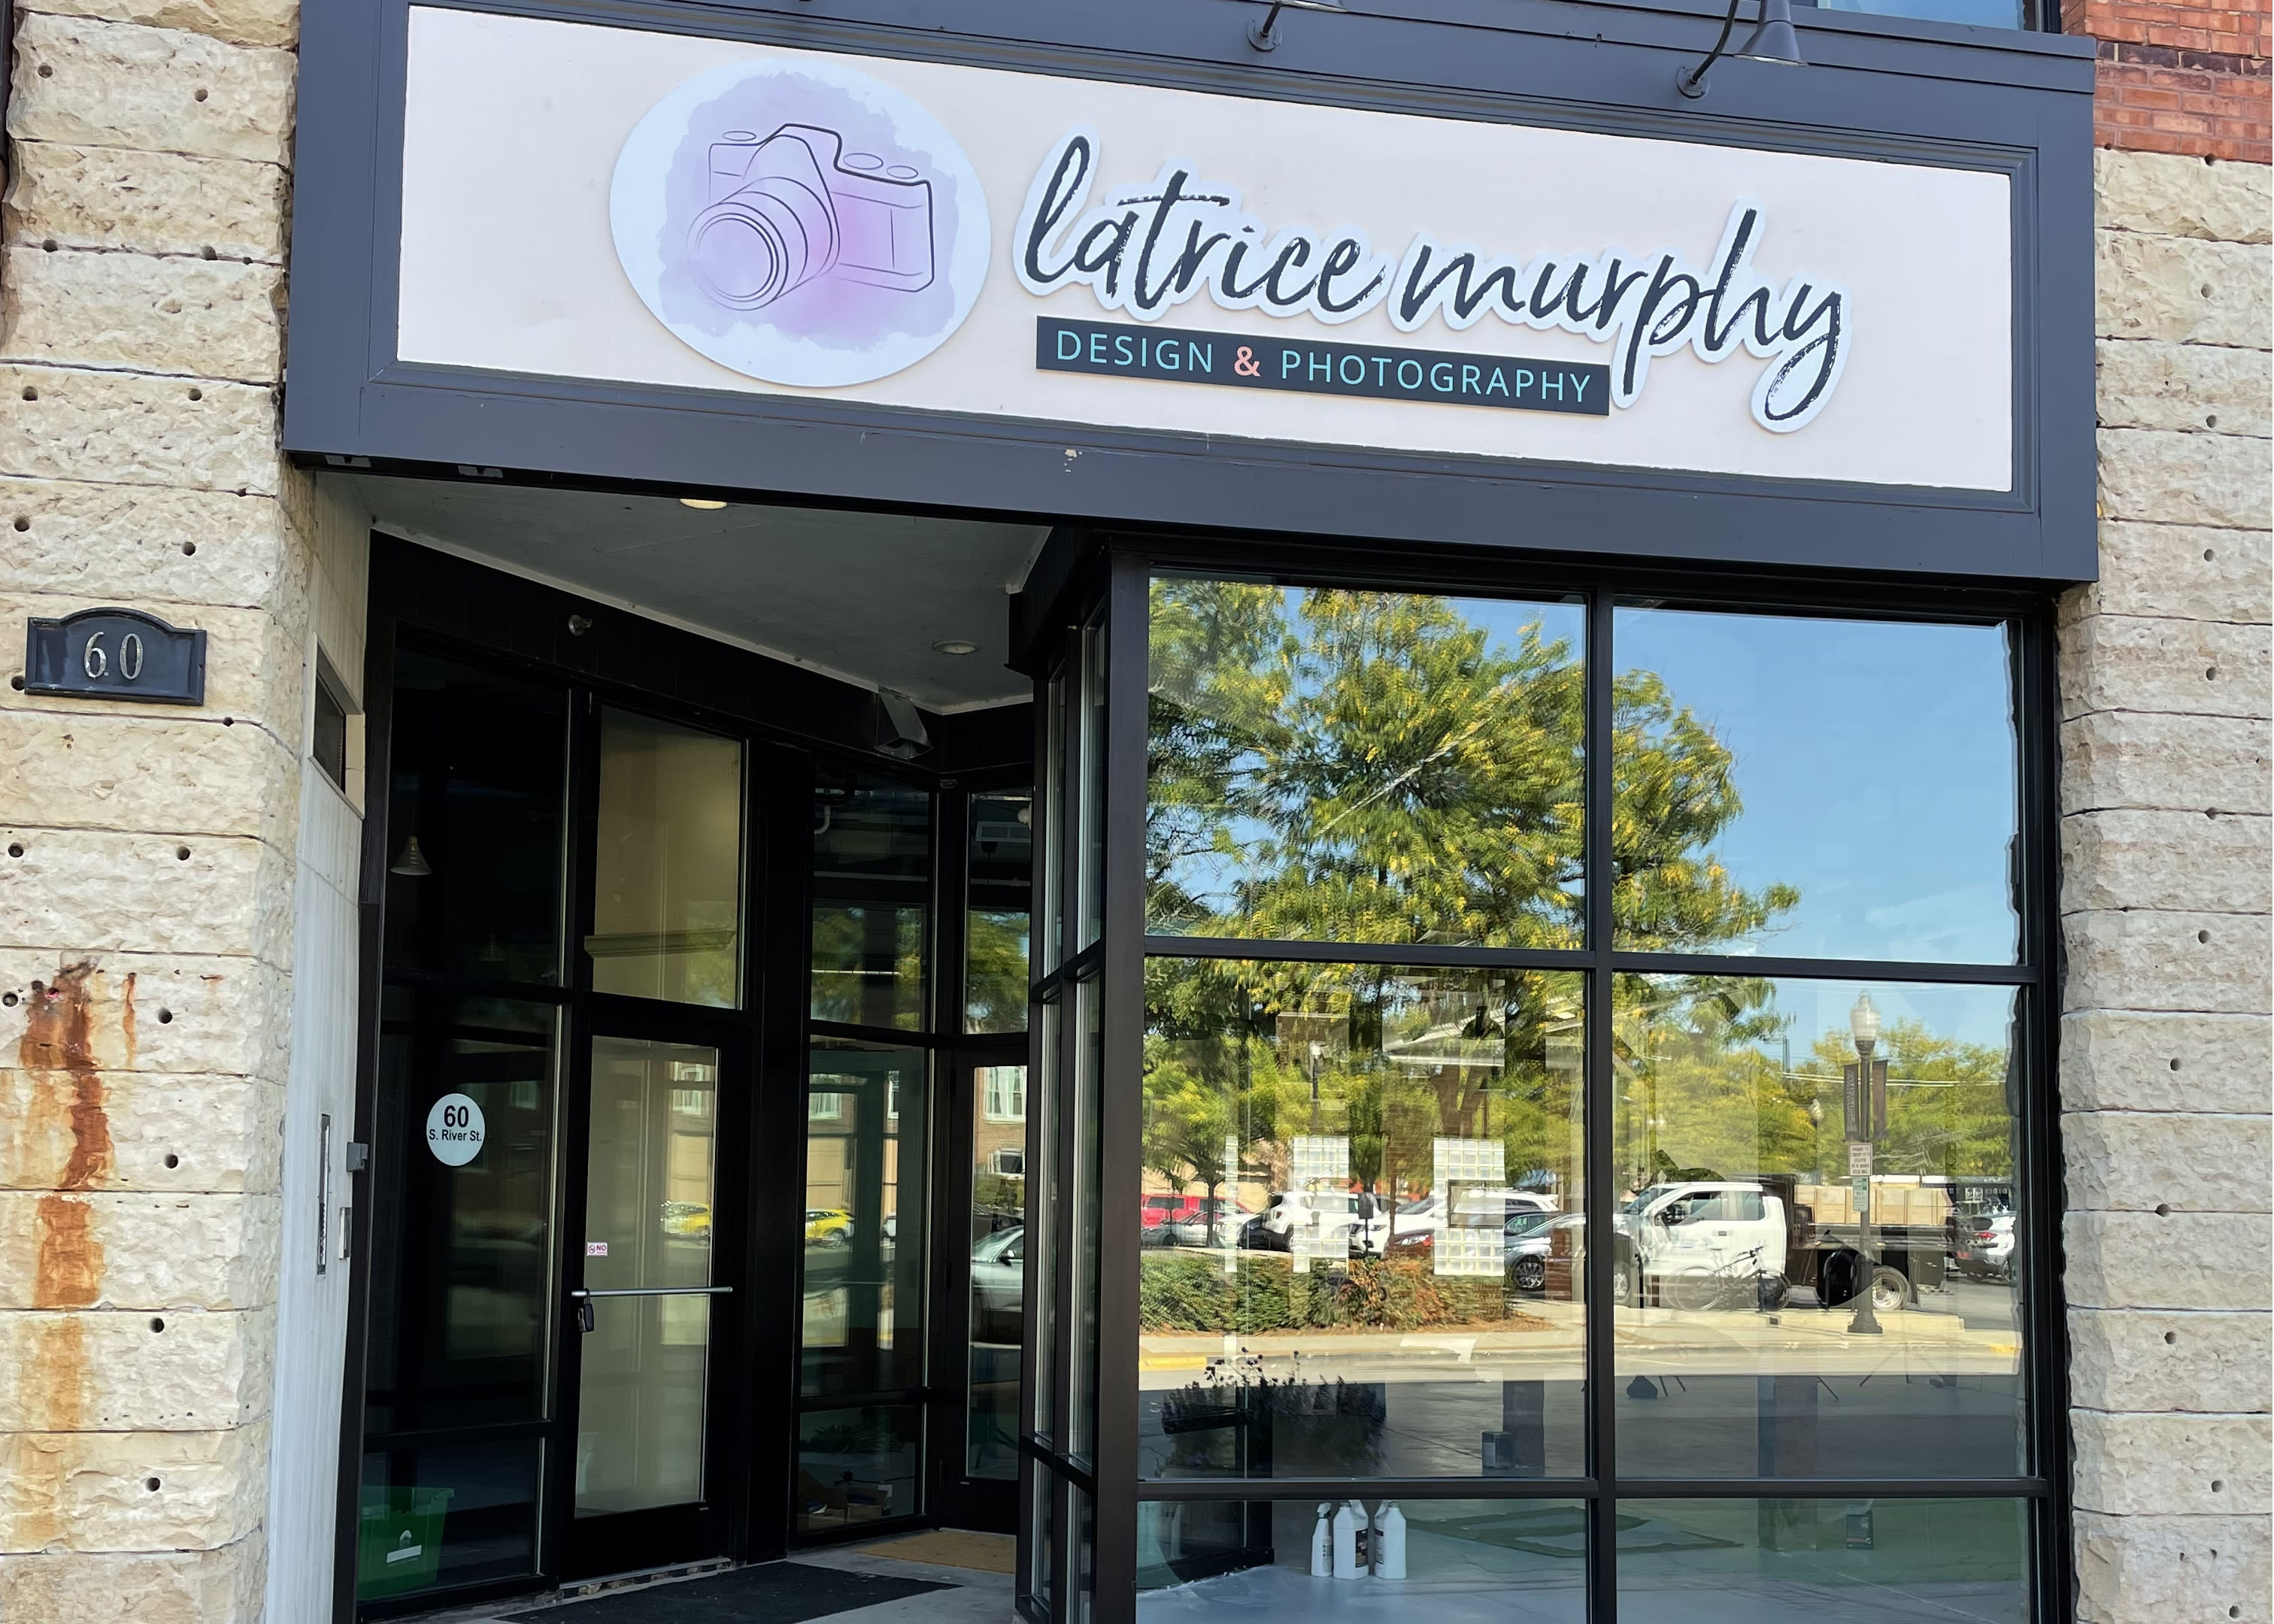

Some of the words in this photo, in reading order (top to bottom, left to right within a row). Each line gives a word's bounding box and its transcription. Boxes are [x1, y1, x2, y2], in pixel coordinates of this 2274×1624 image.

[1024, 135, 1387, 314] latrice
[1399, 208, 1842, 421] murphy
[1057, 329, 1213, 374] DESIGN
[1233, 346, 1262, 377] &
[1281, 349, 1592, 404] PHOTOGRAPHY
[83, 631, 144, 680] 60
[429, 1129, 438, 1141] S.
[441, 1129, 468, 1141] River
[469, 1130, 482, 1142] St.
[444, 1104, 469, 1128] 60
